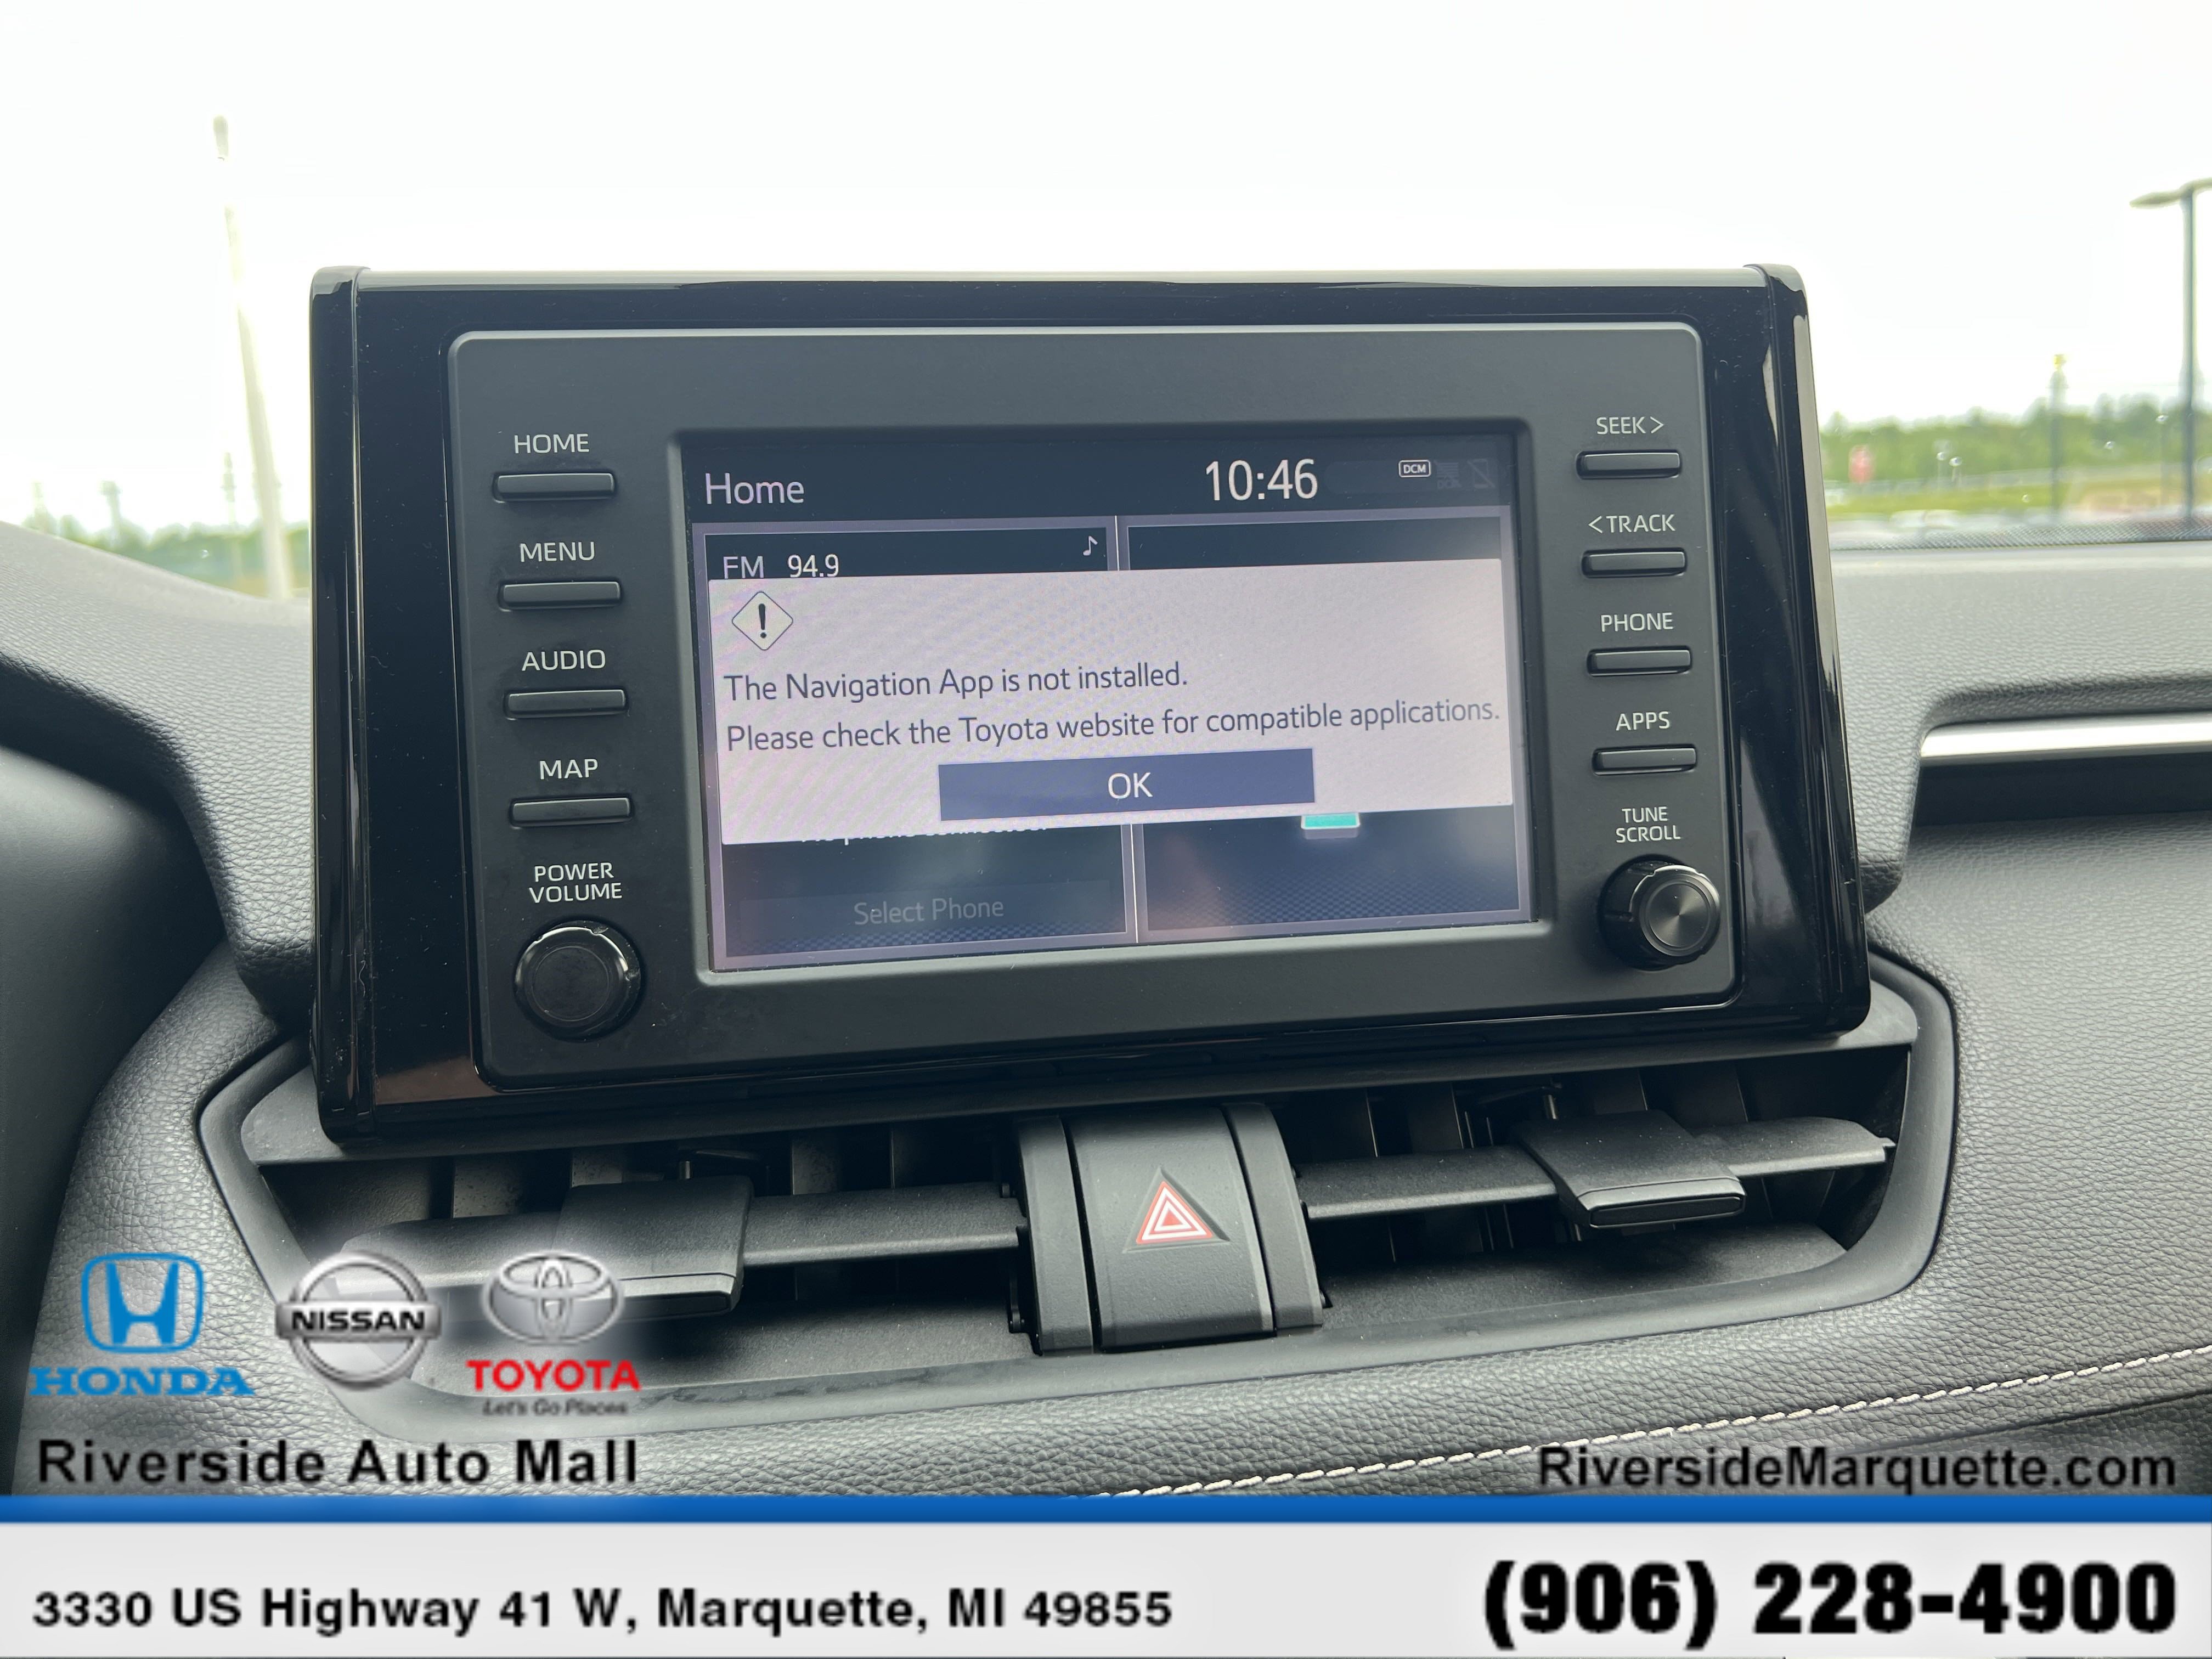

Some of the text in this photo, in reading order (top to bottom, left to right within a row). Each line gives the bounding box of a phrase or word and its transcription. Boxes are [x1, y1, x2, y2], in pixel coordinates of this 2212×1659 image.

[514, 433, 590, 454] HOME
[1205, 459, 1318, 501] 10:46
[1403, 464, 1427, 474] DCM
[705, 472, 805, 504] Home
[520, 541, 596, 562] MENU
[723, 554, 839, 579] FM 94.9
[1601, 612, 1674, 633] PHONE
[522, 649, 606, 671] AUDIO
[723, 661, 1188, 703] The Navigation App is not installed.
[727, 698, 1500, 752] Please check the Toyota website for compatible applications.
[1616, 711, 1671, 731] APPS
[539, 758, 599, 780] MAP
[1108, 772, 1153, 799] OK
[1622, 806, 1668, 823] TUNE
[1616, 825, 1681, 843] SCROLL
[534, 862, 614, 882] POWER
[528, 882, 623, 904] VOLUME
[854, 897, 1005, 926] Select Phone
